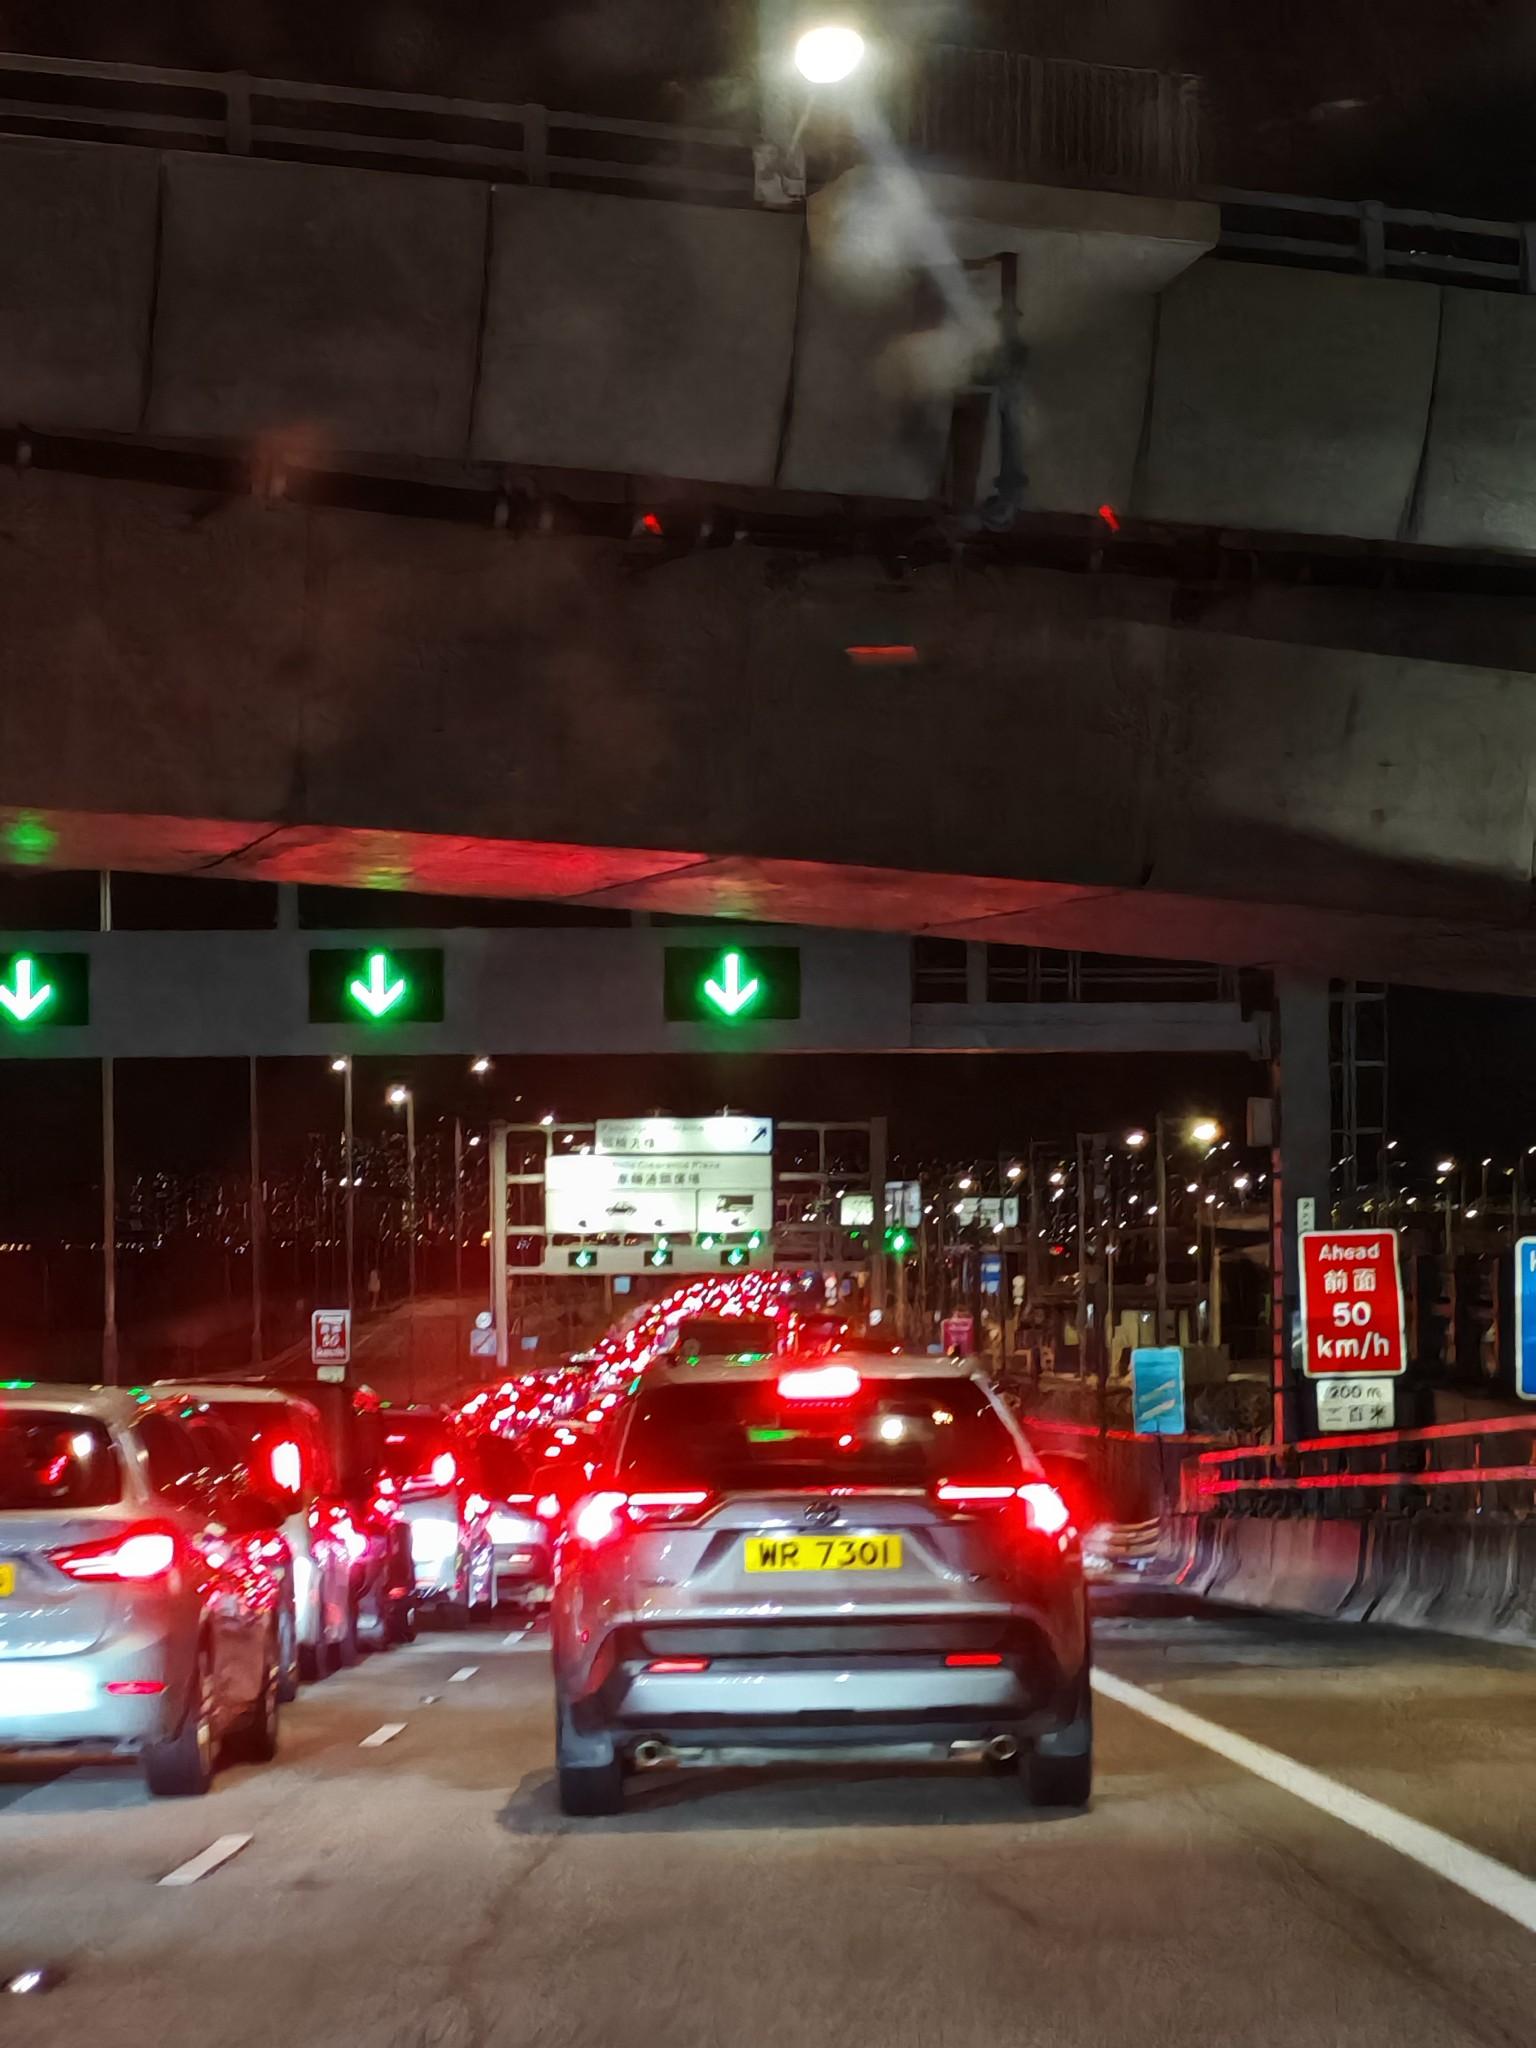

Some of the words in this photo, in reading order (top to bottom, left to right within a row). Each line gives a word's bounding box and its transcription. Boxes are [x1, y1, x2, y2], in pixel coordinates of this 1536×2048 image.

[1319, 1242, 1380, 1261] Ahead
[1324, 1268, 1376, 1294] 前面
[1333, 1301, 1371, 1327] 50
[1317, 1331, 1389, 1360] km/h
[1329, 1385, 1362, 1399] 200
[760, 1541, 799, 1567] WR
[816, 1540, 888, 1567] 7301
